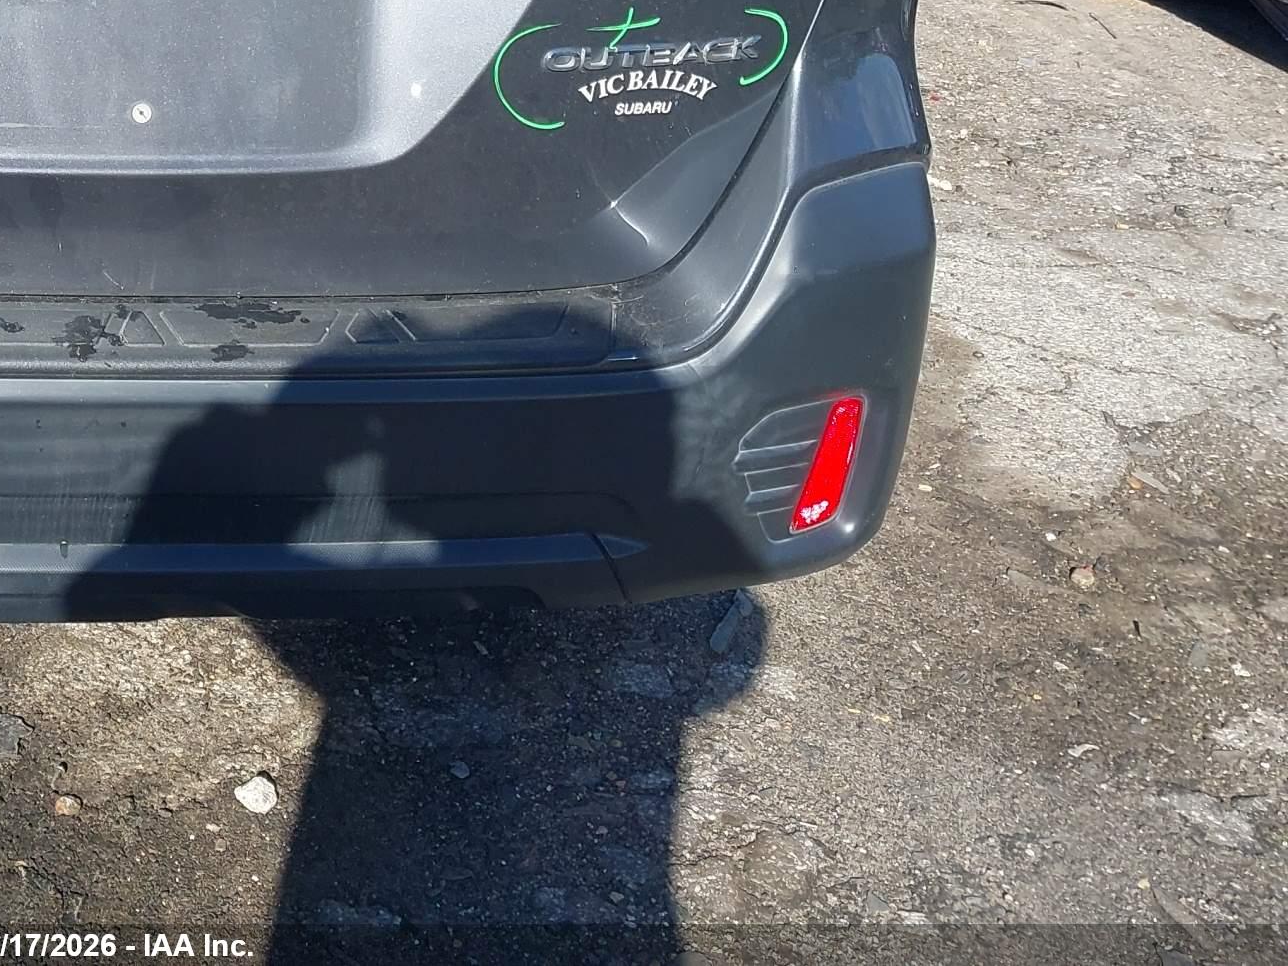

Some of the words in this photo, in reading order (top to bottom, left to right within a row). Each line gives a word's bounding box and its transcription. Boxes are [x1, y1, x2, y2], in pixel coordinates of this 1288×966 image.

[542, 35, 763, 72] OUTBACK
[578, 73, 624, 103] VIC
[626, 69, 718, 101] BAILEY
[614, 101, 673, 116] SUBARU
